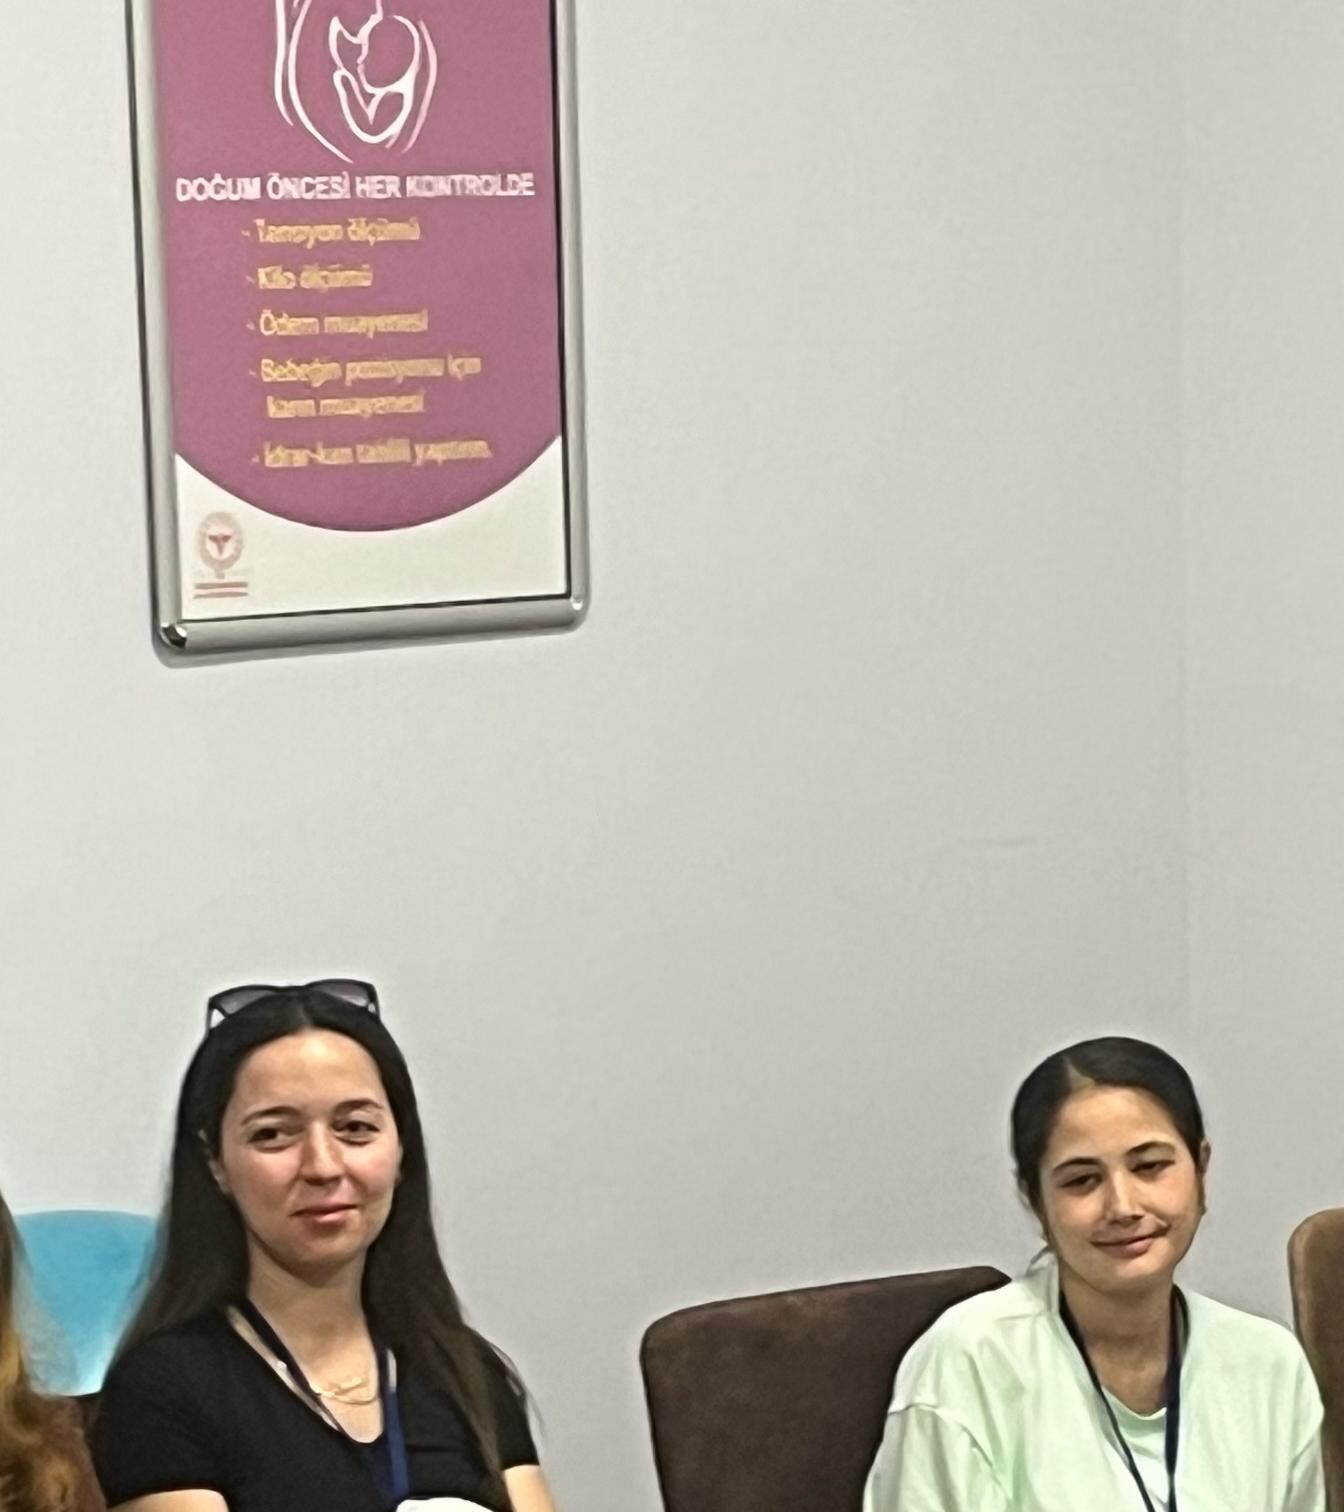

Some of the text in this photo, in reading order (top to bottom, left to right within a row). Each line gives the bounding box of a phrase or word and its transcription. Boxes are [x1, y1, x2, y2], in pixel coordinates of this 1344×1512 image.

[175, 171, 536, 202] DOĞUM ÖNCESİ HER KONTROLDE
